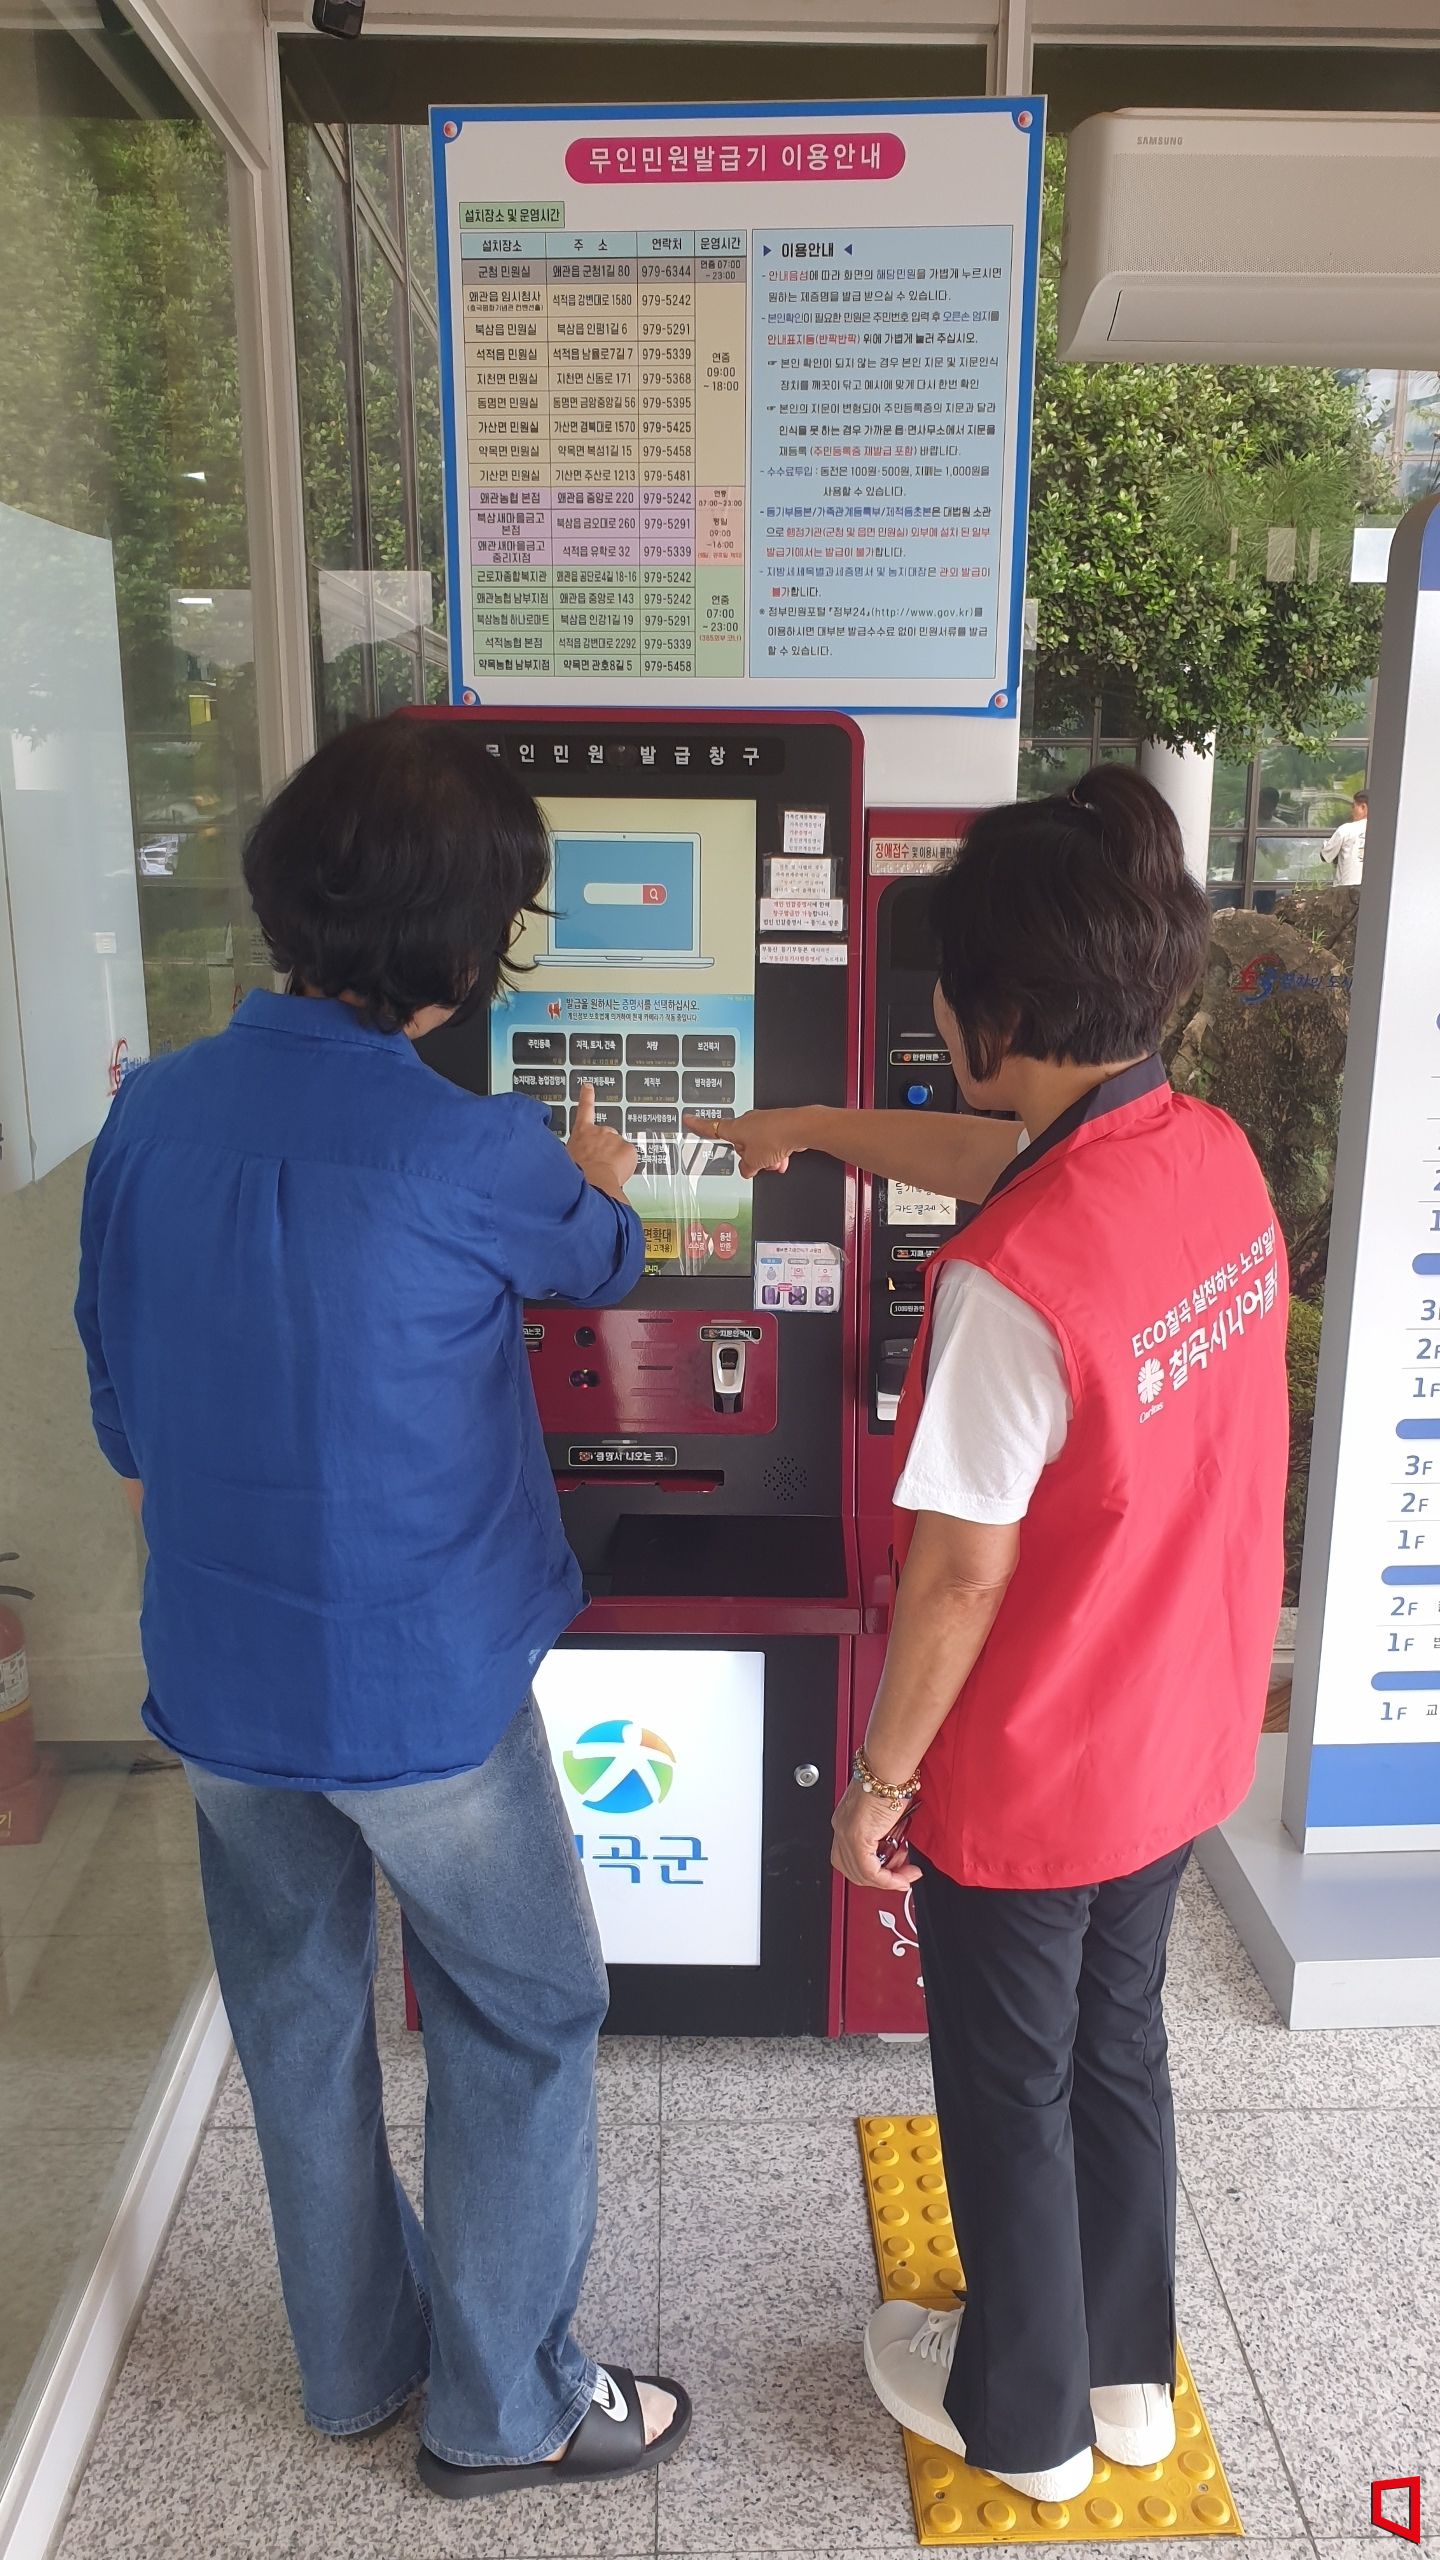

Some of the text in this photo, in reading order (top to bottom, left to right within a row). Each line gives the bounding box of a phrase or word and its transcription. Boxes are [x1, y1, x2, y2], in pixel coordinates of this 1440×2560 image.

[1137, 137, 1182, 145] SAMSUNG
[590, 143, 880, 173] 무인민원발급기 이용안내
[466, 209, 559, 222] 설치장소 및 운영시간
[483, 240, 522, 252] 설치장소
[652, 238, 681, 250] 연락처
[701, 237, 740, 250] 운영시간
[782, 243, 833, 258] 이용안내
[479, 260, 740, 278] 군청 민원실 왜관읍 군청1길 80 979-6344 연중 07:00
[769, 268, 1001, 281] 안내음성에 따라 화면의 해당민원을 가볍게 누르시면
[469, 291, 691, 306] 왜관읍 임시청사 석적읍 강변대로 1580 979-5242
[769, 290, 951, 302] 원하는 제증명을 발급 받으실 수 있습니다.
[476, 323, 690, 336] 북삼읍 민원실 북삼읍 인평1길 6 979-5291
[713, 353, 730, 363] 연중
[707, 367, 735, 377] 09:00
[477, 373, 691, 385] 지천면 민원실 지천면 신동로 171 979-5368
[478, 397, 691, 409] 동명면 민원실 동명면 금암중앙길 56 979-5395
[479, 421, 691, 433] 가산면 민원실 가산면 경북대로 1570 979-5425
[480, 470, 690, 481] 기산면 민원실 기산면 주산로 1213 979-5481
[824, 486, 906, 496] 사용할 수 있습니다.
[480, 492, 691, 504] 왜관농협 본점 왜관읍 중앙로 220 979-5242
[767, 547, 905, 557] 발급기에서는 발급이 불가합니다.
[769, 607, 825, 617] 정부민원포털
[768, 646, 832, 656] 할 수 있습니다.
[479, 660, 691, 672] 약목농협 남부지점 약목면 관호8길 5 979-5458
[641, 746, 759, 766] 발급창구
[876, 843, 909, 859] 장애접수
[920, 847, 938, 858] 이용시
[566, 999, 700, 1011] 발급을 원하시는 증명서를 선택하십시오.
[528, 1039, 551, 1049] 주민등록
[647, 1042, 658, 1050] 차량
[643, 1227, 671, 1243] 면확대
[1132, 1299, 1191, 1358] ECO칠곡
[1192, 1263, 1238, 1315] 실천하는
[1405, 1455, 1433, 1476] 3F
[1400, 1492, 1429, 1513] 2F
[1397, 1530, 1425, 1550] 1F
[1390, 1596, 1418, 1616] 2F
[1387, 1633, 1414, 1652] 1F
[1380, 1702, 1408, 1721] 1F
[571, 1834, 709, 1885] 곡군
